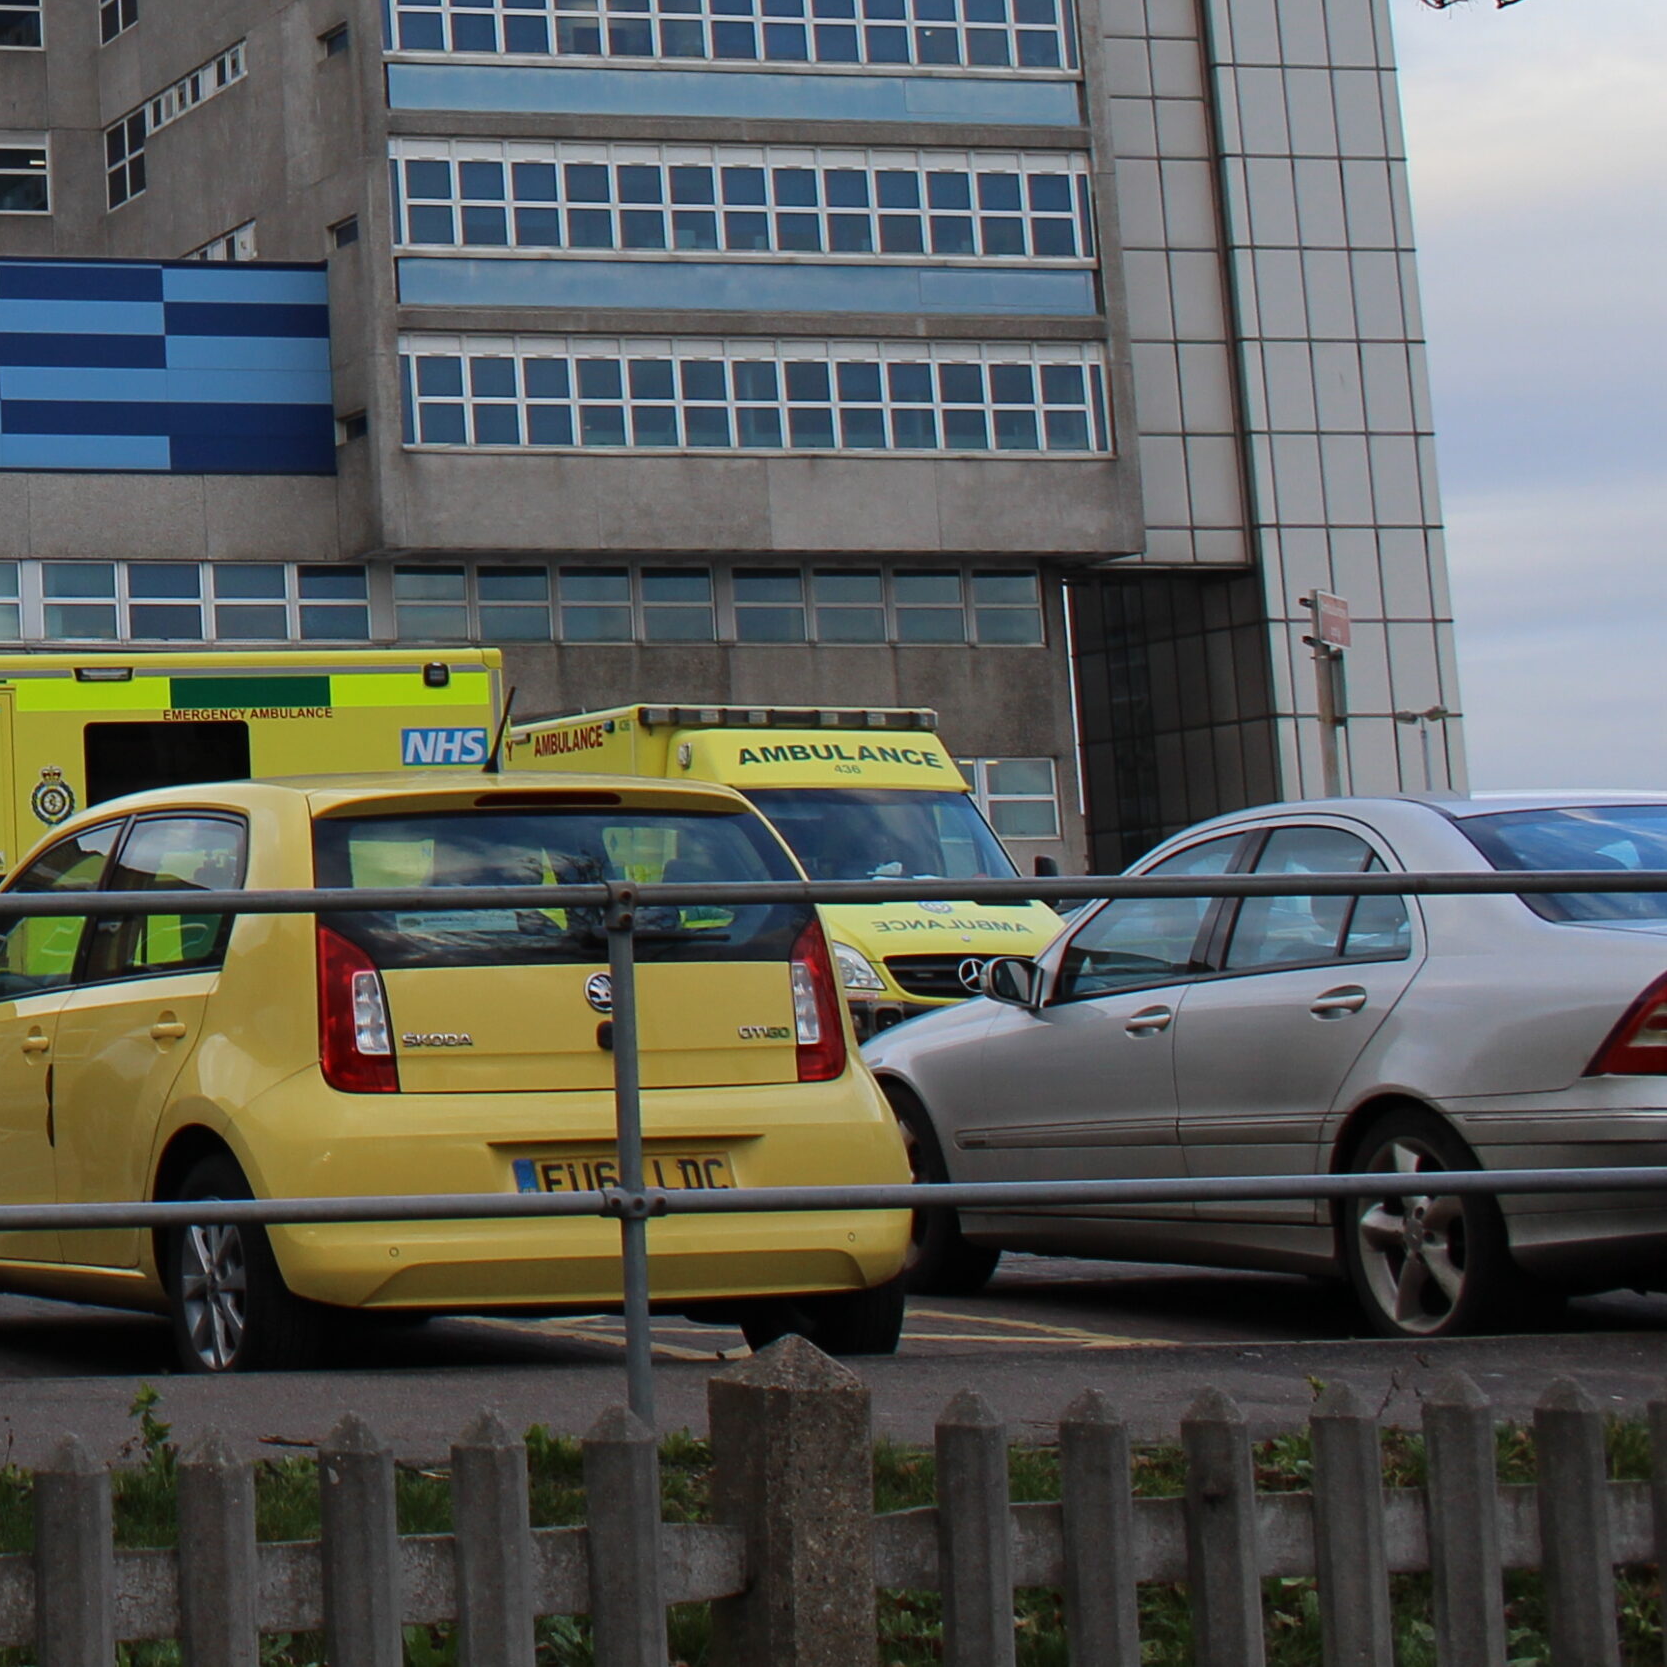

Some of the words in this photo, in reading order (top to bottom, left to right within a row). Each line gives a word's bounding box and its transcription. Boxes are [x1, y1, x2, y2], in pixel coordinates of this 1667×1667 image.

[163, 709, 248, 721] EMERGENCY
[250, 707, 334, 720] AMBULANCE
[404, 730, 485, 764] NHS
[533, 724, 604, 758] AMBULANCE
[738, 744, 945, 770] AMBULANCE
